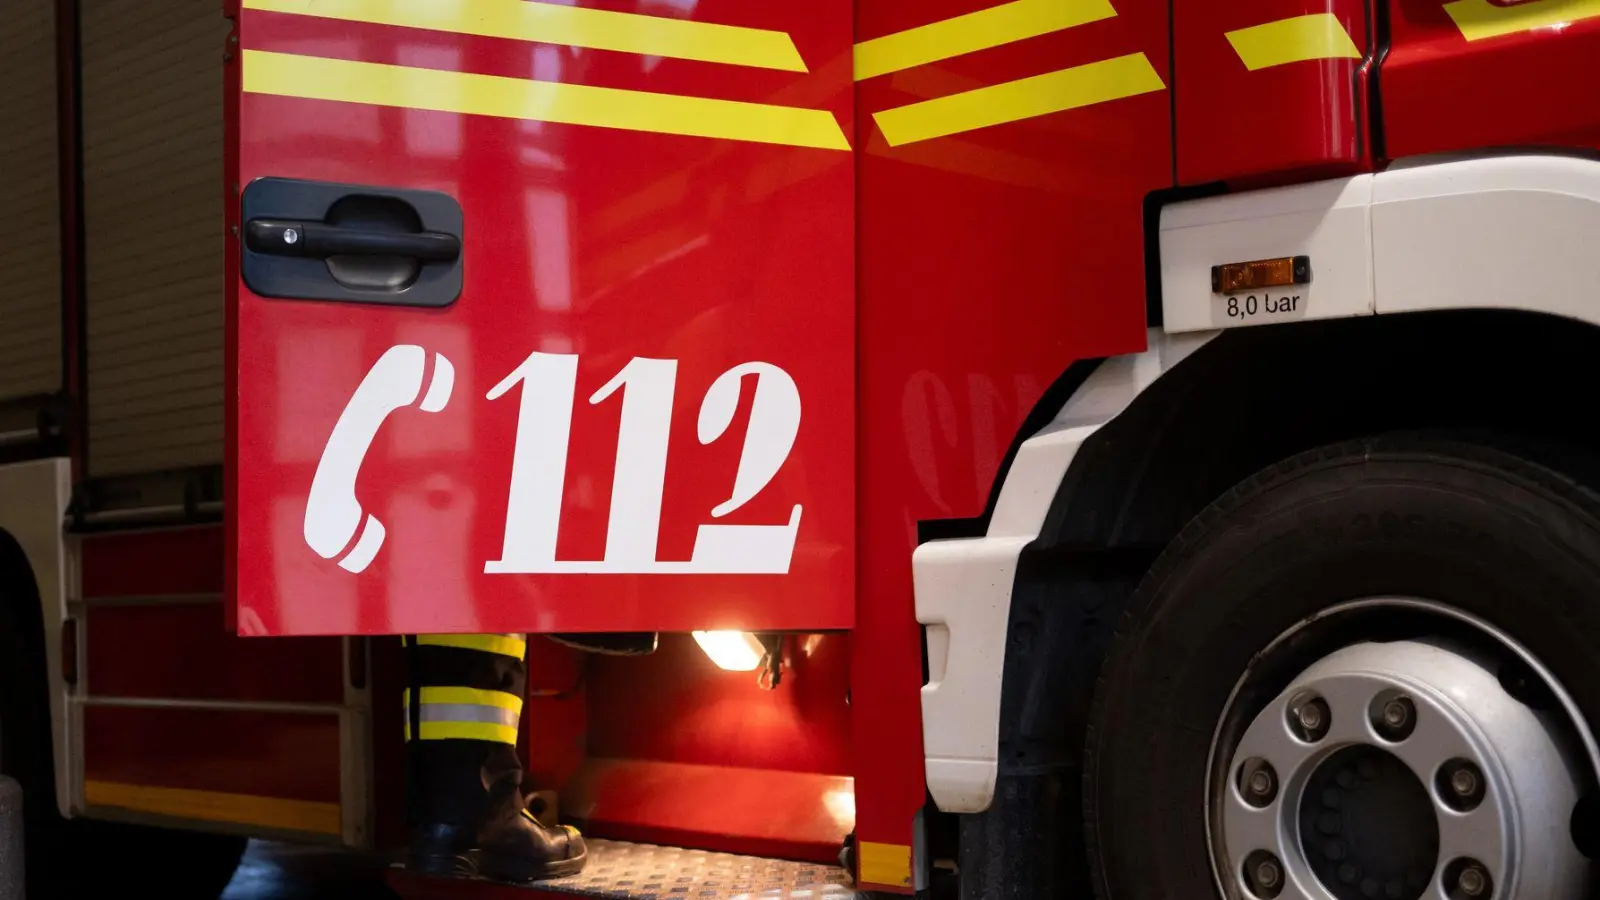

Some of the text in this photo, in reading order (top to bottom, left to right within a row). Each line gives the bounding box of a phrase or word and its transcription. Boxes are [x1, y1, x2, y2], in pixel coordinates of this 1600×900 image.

[1227, 293, 1300, 320] 8,0 bar
[484, 352, 803, 574] 112
